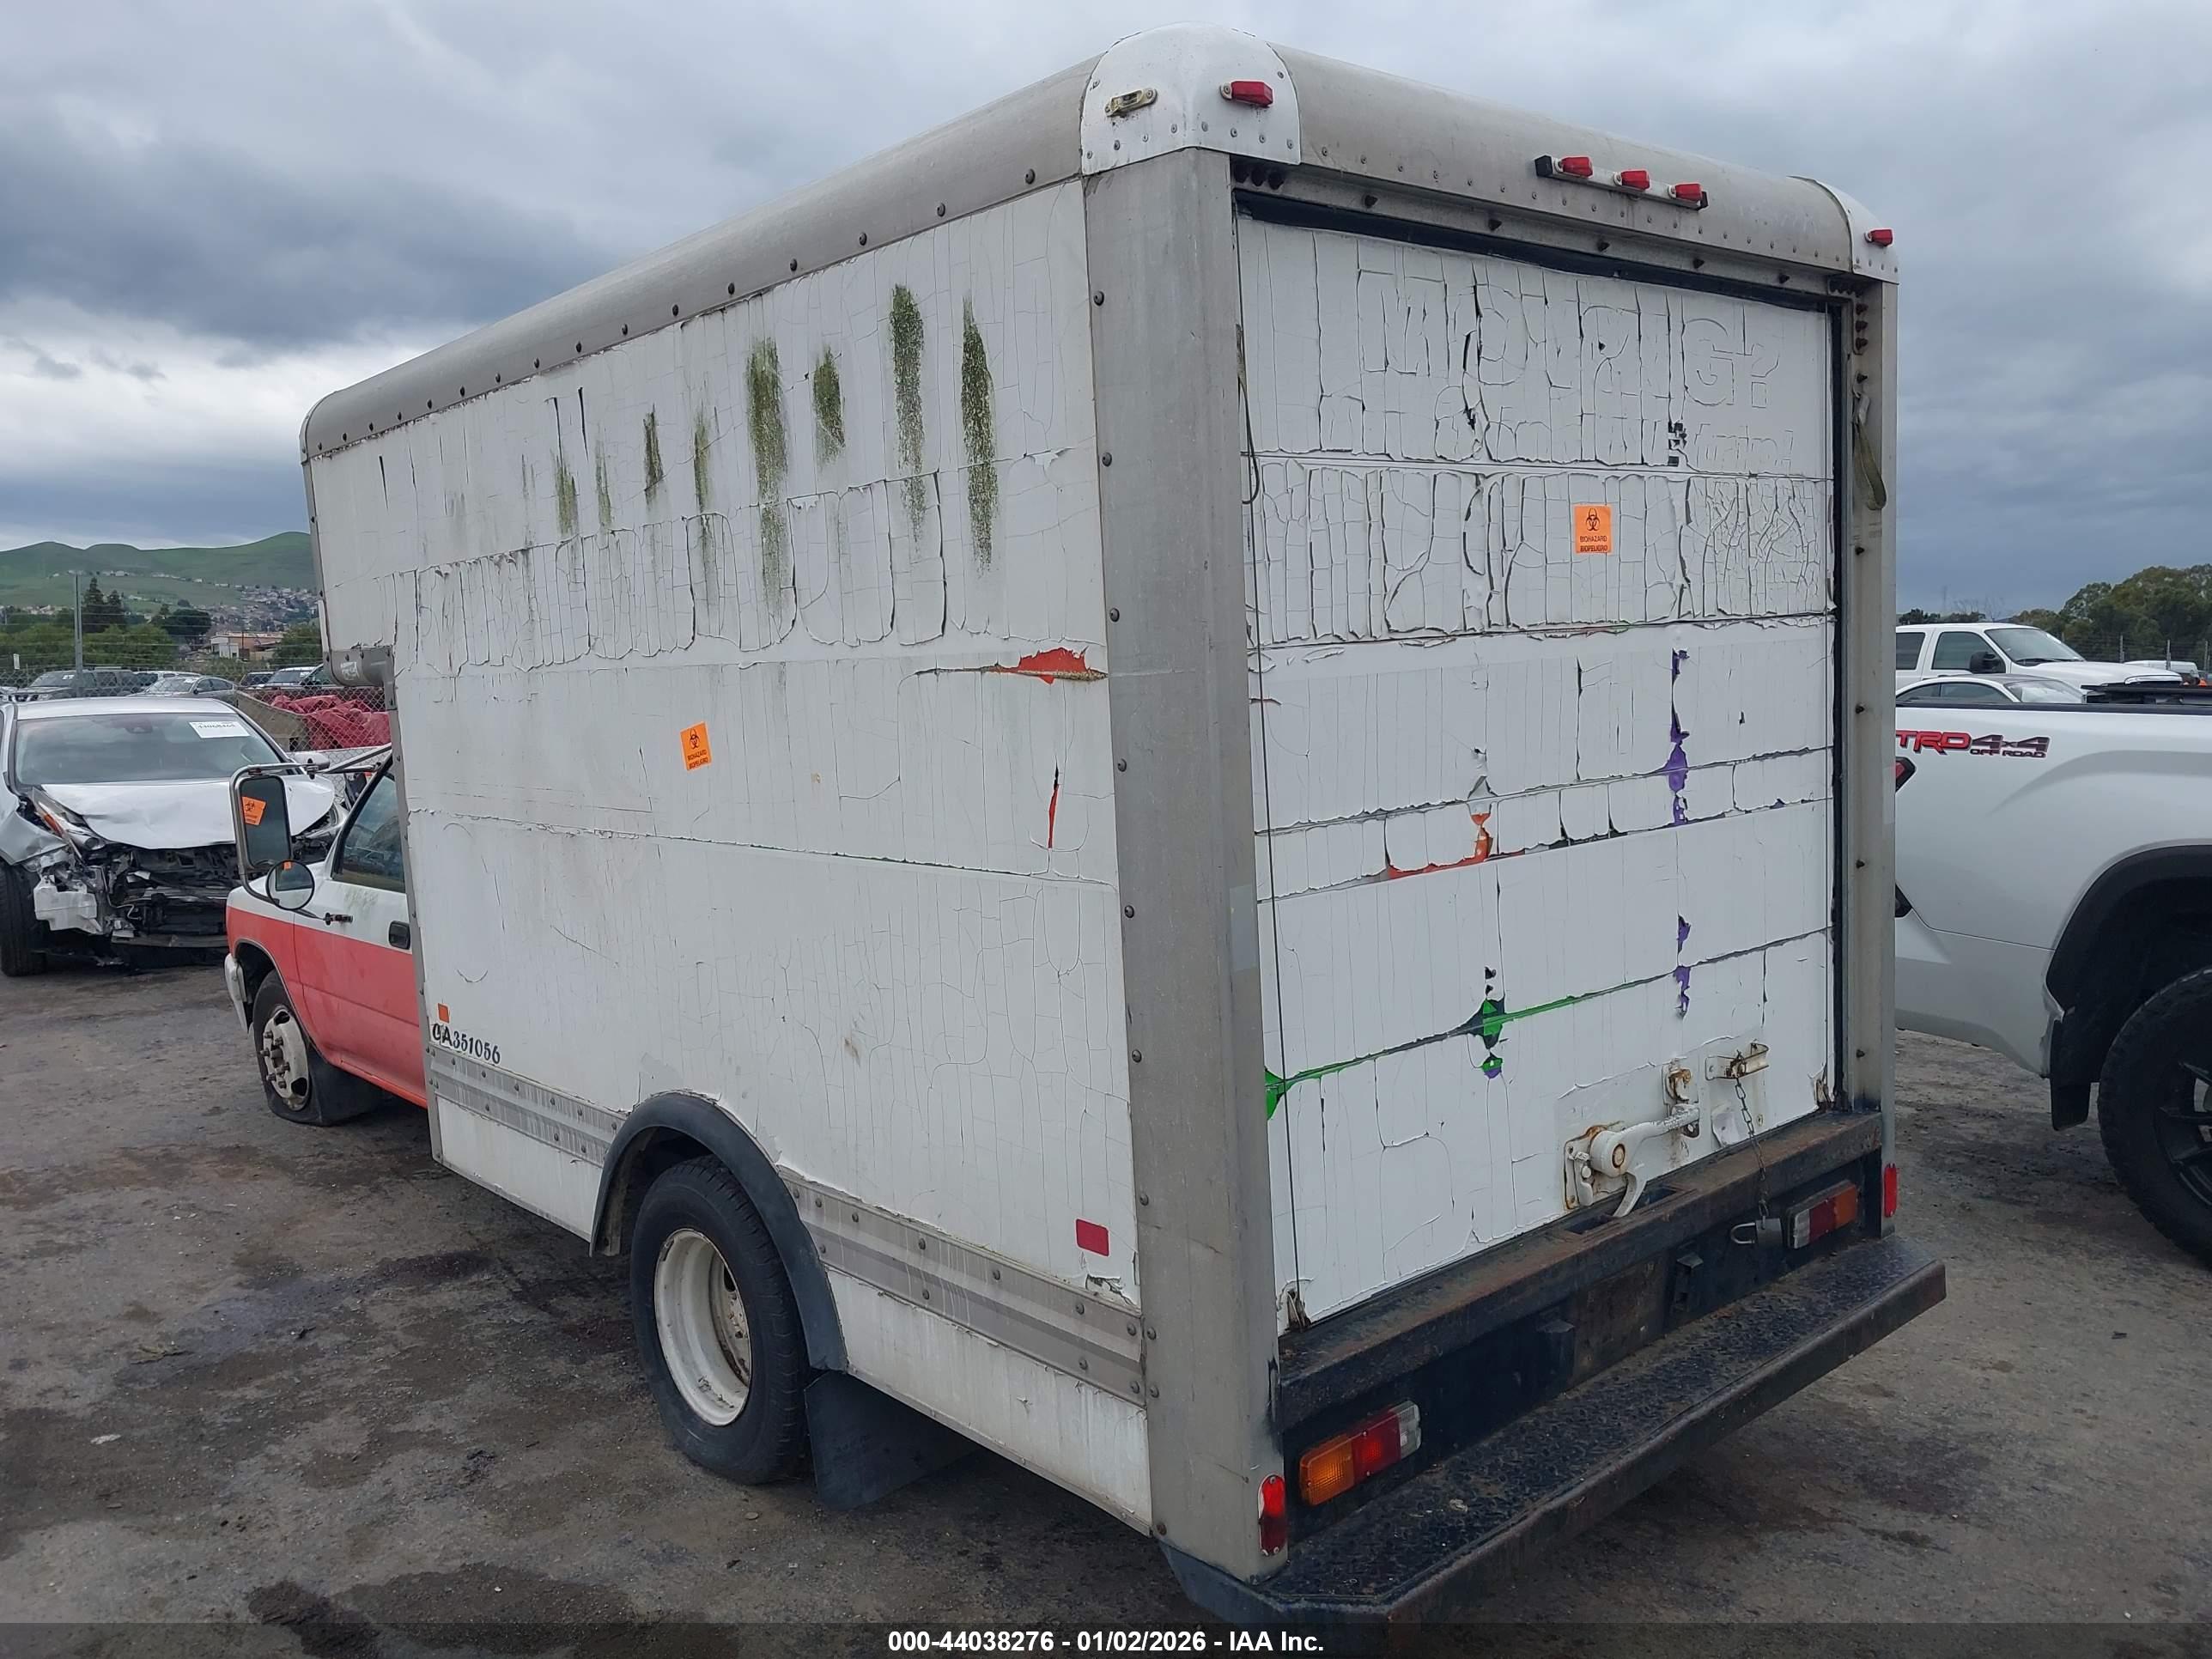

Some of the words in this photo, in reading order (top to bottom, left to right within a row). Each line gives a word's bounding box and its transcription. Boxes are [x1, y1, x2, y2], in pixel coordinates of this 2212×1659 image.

[1896, 730, 1972, 755] TRD
[1972, 734, 2051, 752] 4x4
[2002, 750, 2047, 758] ROAD
[432, 1023, 501, 1064] CA351056
